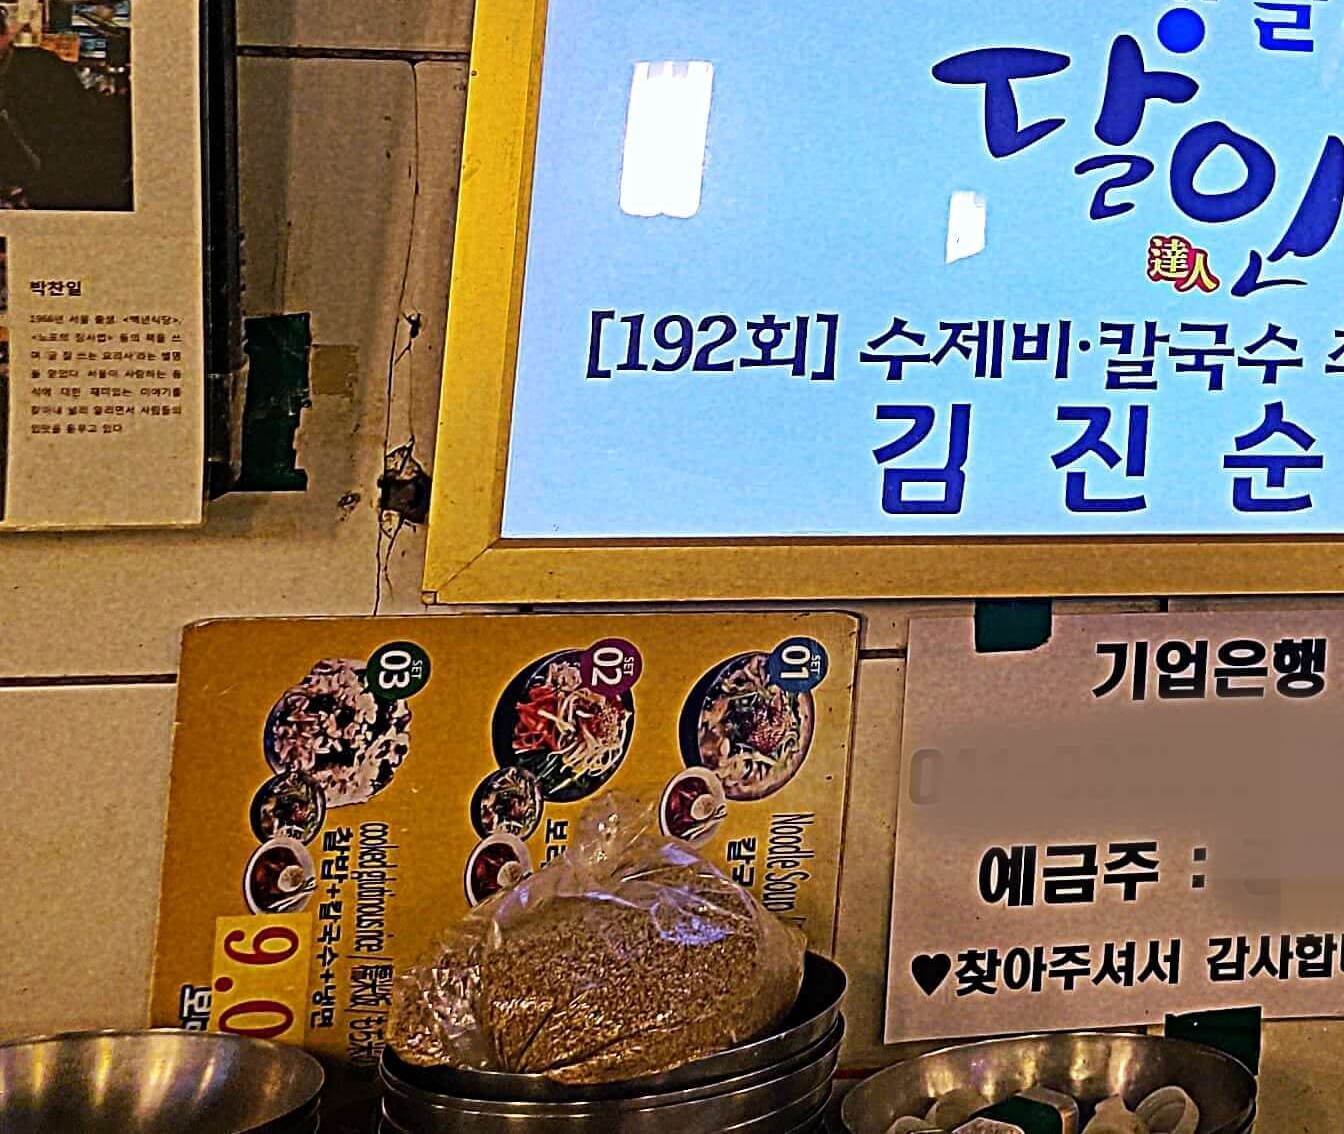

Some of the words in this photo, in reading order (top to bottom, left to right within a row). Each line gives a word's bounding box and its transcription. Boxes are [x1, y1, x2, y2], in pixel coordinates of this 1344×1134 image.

[30, 280, 82, 297] 박찬일
[585, 309, 840, 384] [192회]
[378, 649, 412, 690] 03
[410, 659, 424, 680] SET
[591, 647, 624, 686] 02
[623, 656, 635, 677] SET
[780, 645, 811, 679] 01
[810, 654, 821, 675] SET
[1092, 637, 1328, 701] 기업은행
[358, 822, 400, 868] cooked
[766, 812, 816, 869] Noodle
[977, 840, 1160, 908] 예금주
[955, 938, 1183, 998] 찾아주셔서
